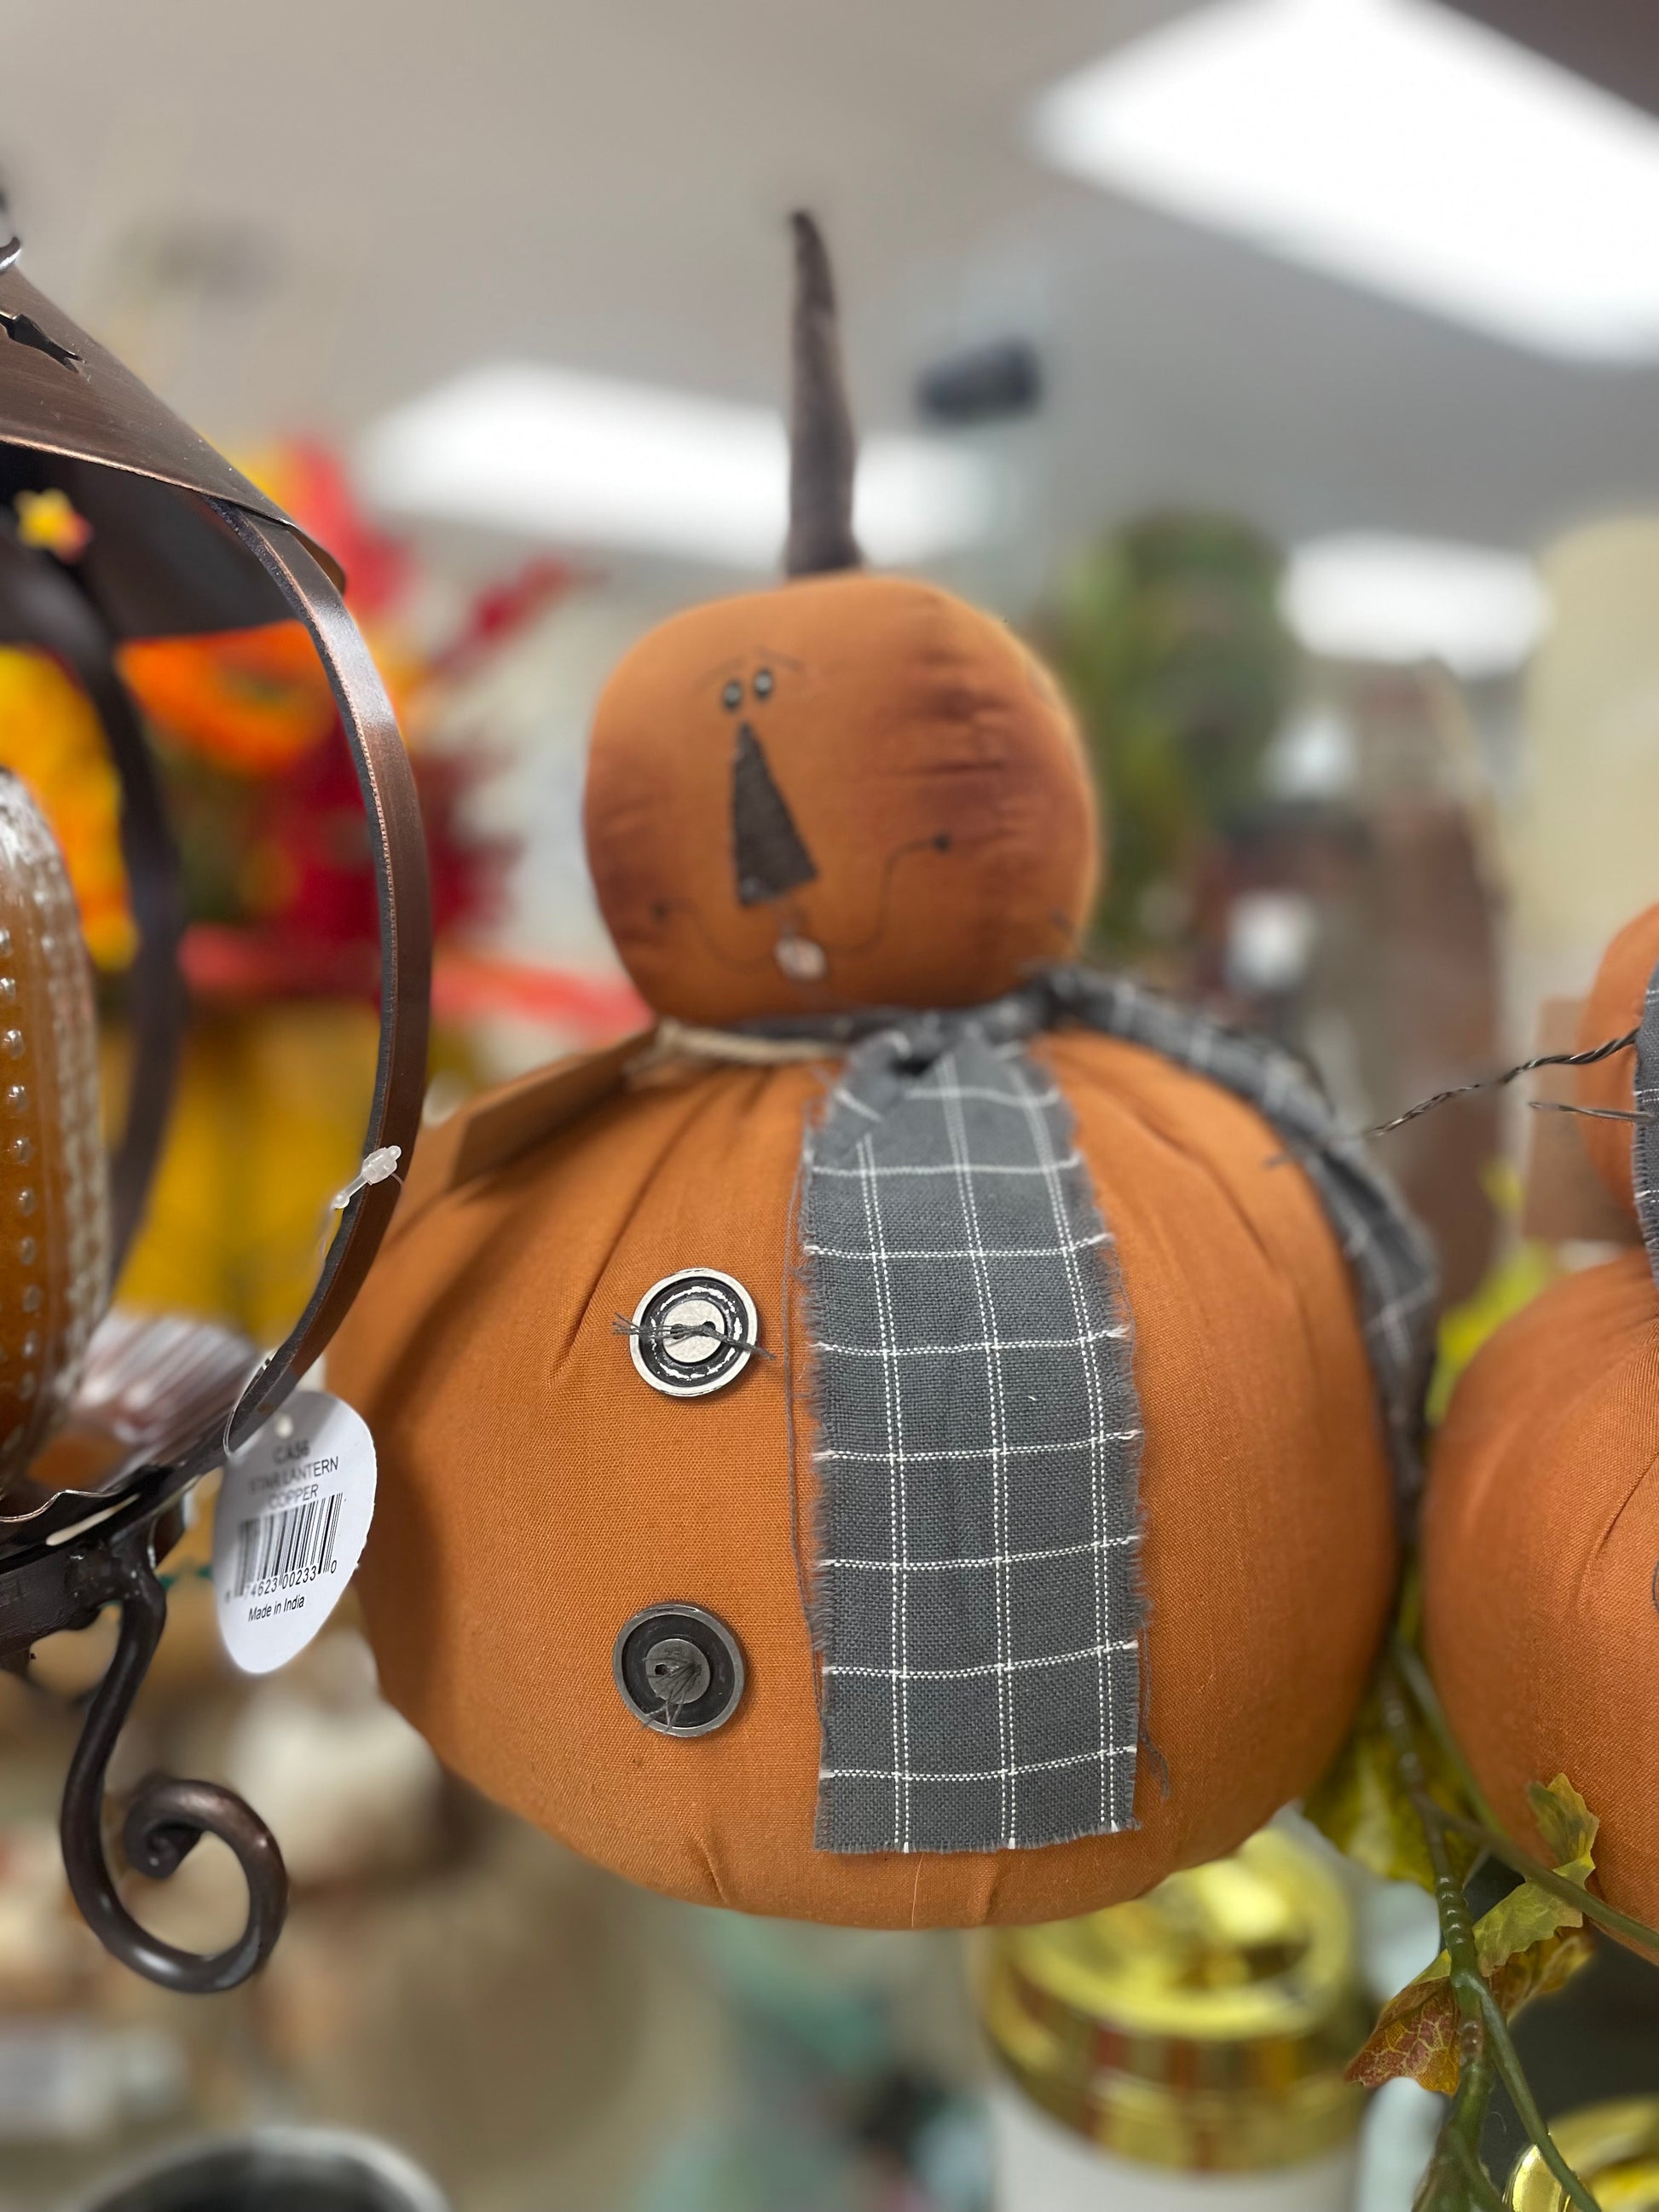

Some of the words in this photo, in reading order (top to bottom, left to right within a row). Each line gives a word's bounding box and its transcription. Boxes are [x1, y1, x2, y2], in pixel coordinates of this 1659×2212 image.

[282, 1456, 338, 1485] LANTERN
[269, 1484, 319, 1508] COPPER
[248, 1604, 271, 1622] Made
[274, 1601, 281, 1615] in
[283, 1595, 305, 1613] India
